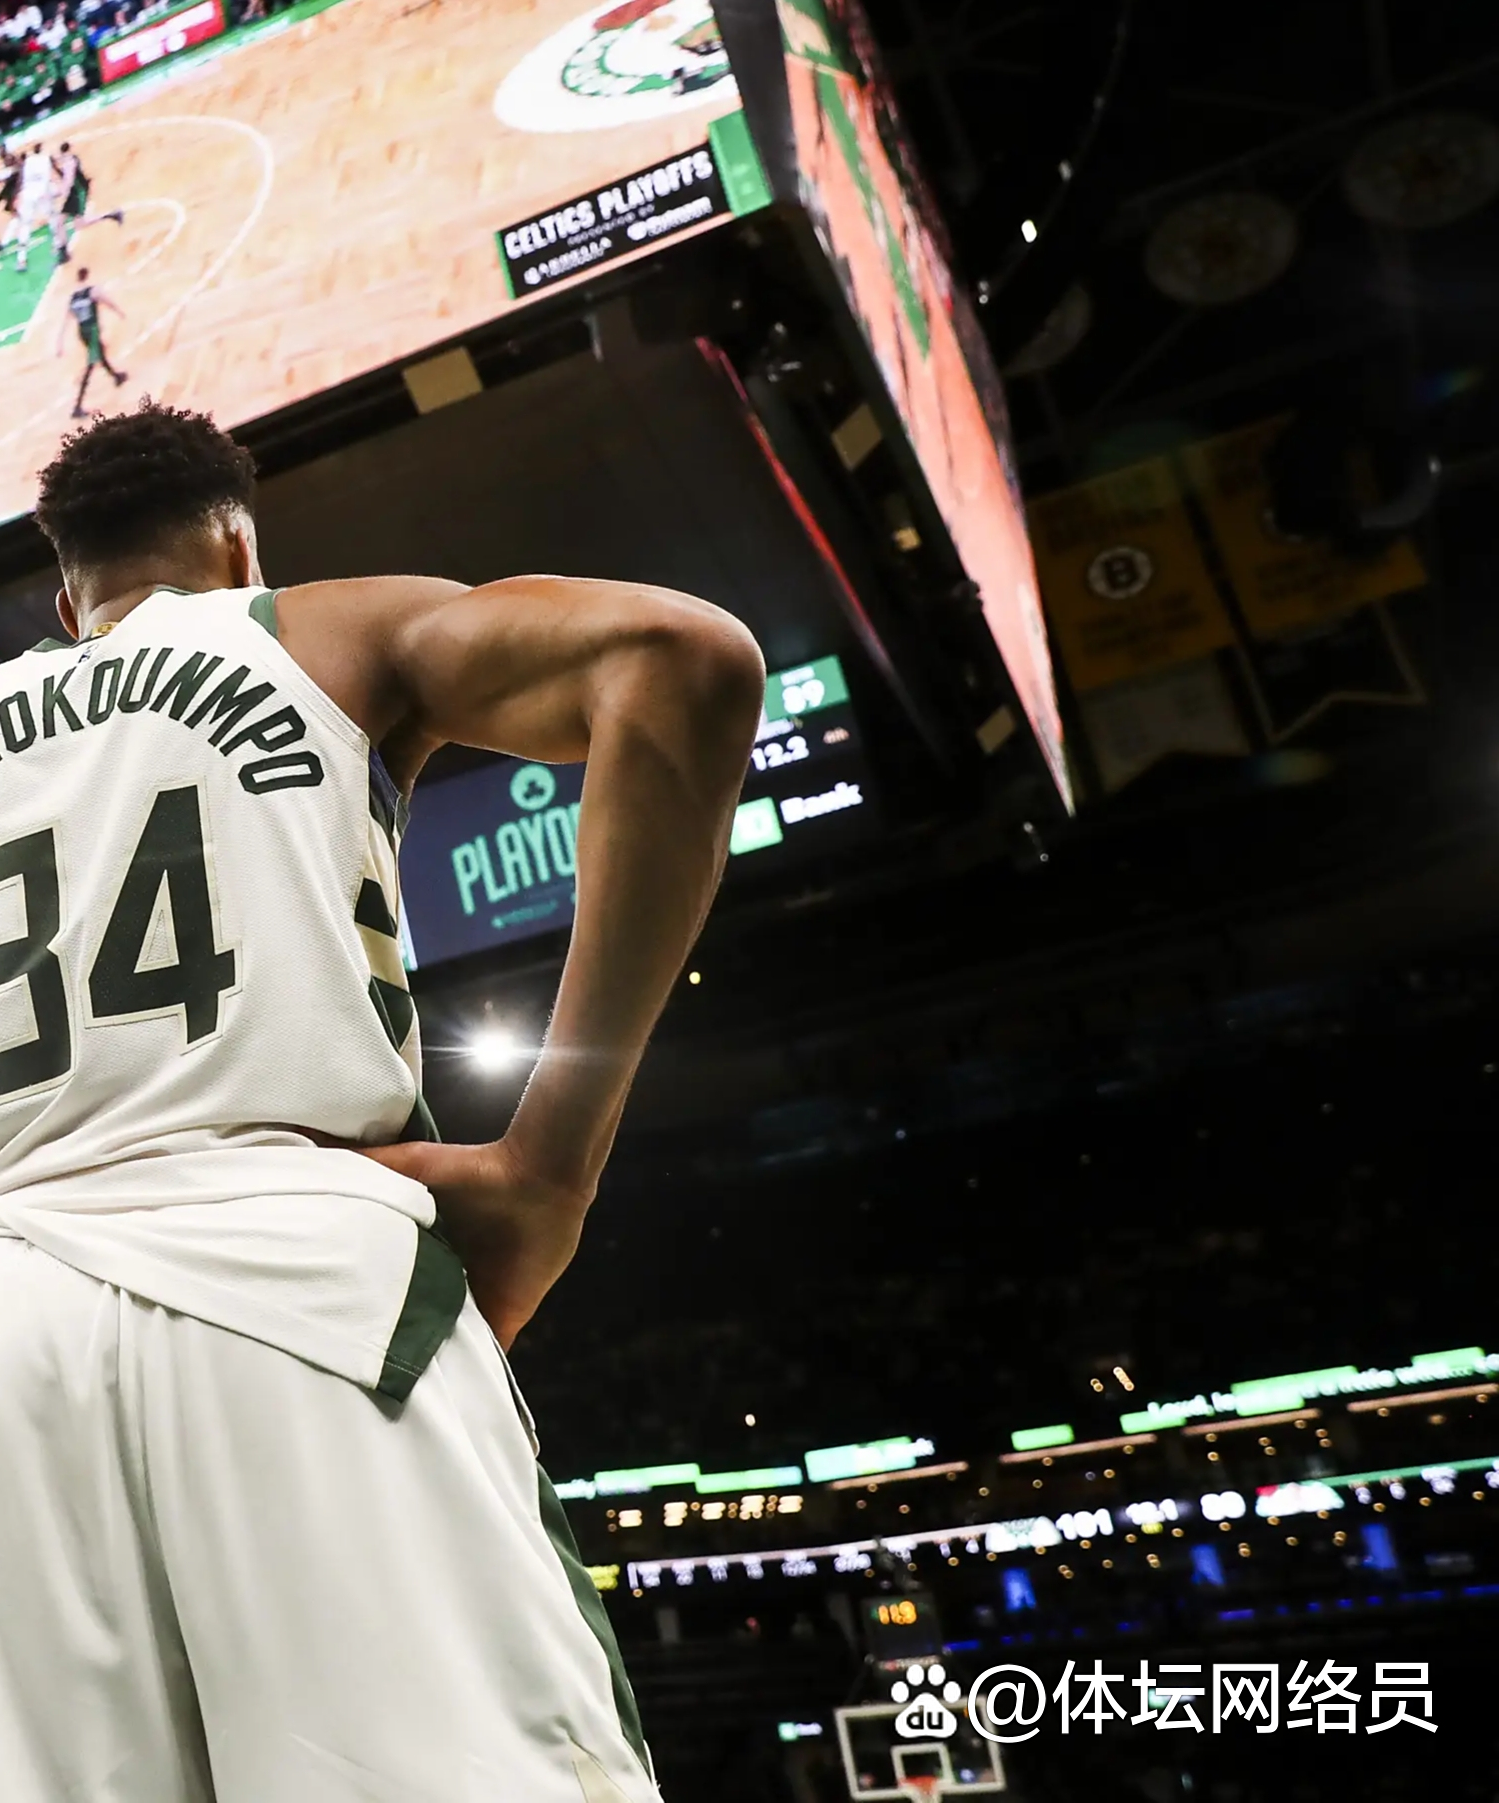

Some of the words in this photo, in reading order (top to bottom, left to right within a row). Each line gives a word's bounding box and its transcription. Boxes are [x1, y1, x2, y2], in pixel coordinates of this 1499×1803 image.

[504, 200, 595, 260] CELTICS
[596, 150, 713, 220] PLAYOFFS
[451, 802, 580, 916] PLAYO
